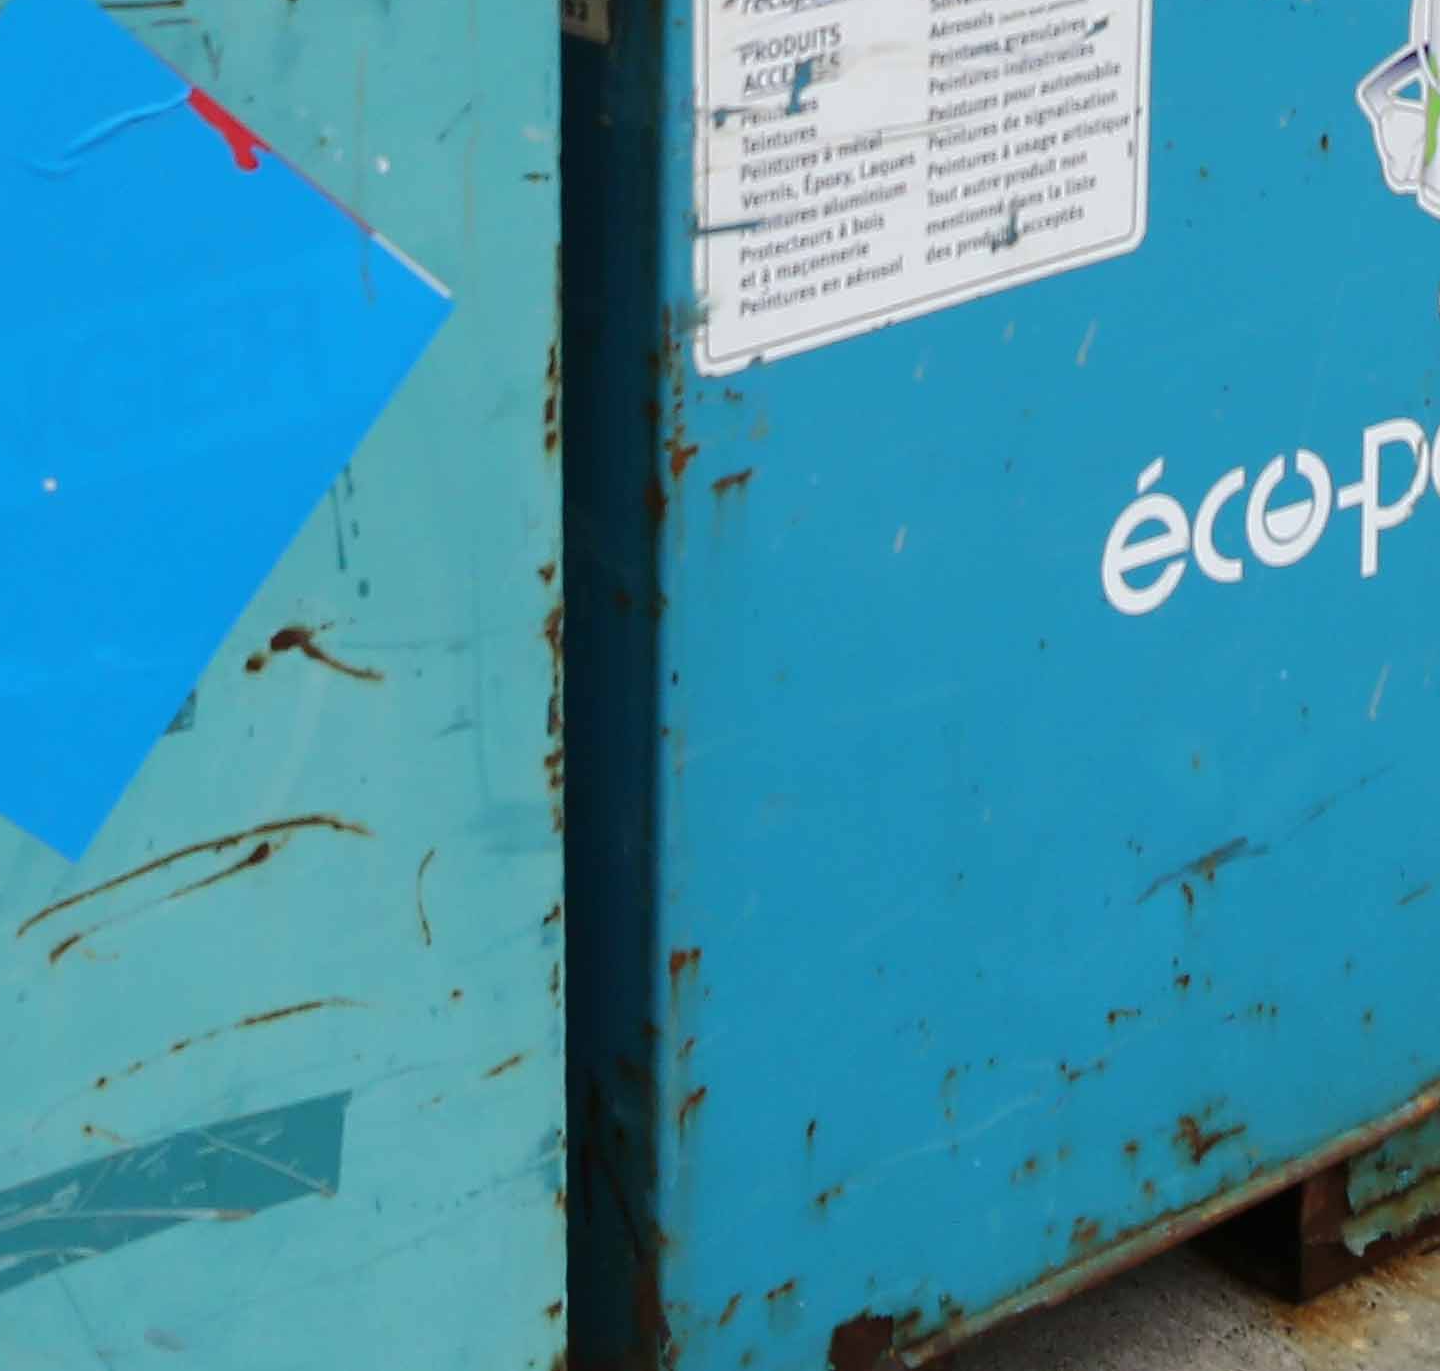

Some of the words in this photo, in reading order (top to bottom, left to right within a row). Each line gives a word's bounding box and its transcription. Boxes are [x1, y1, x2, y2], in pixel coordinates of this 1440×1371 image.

[740, 23, 841, 66] PRODUITS
[929, 68, 999, 95] Peintures
[929, 96, 998, 123] Peintures
[1003, 86, 1036, 108] pour
[1040, 61, 1121, 95] automobile
[742, 125, 817, 155] Teintures
[928, 121, 998, 150] Peintures
[1002, 115, 1020, 133] de
[1024, 89, 1118, 126] signalisation
[741, 152, 818, 181] Peintures
[861, 151, 915, 178] Laques
[928, 148, 997, 179] Peintures
[1015, 133, 1057, 155] usage
[1062, 112, 1131, 142] artistique
[962, 176, 1001, 197] autre
[1005, 158, 1057, 189] produit
[1061, 150, 1088, 169] non
[740, 228, 834, 264] Protecteurs
[852, 211, 885, 234] bois
[740, 285, 818, 316] Peintures
